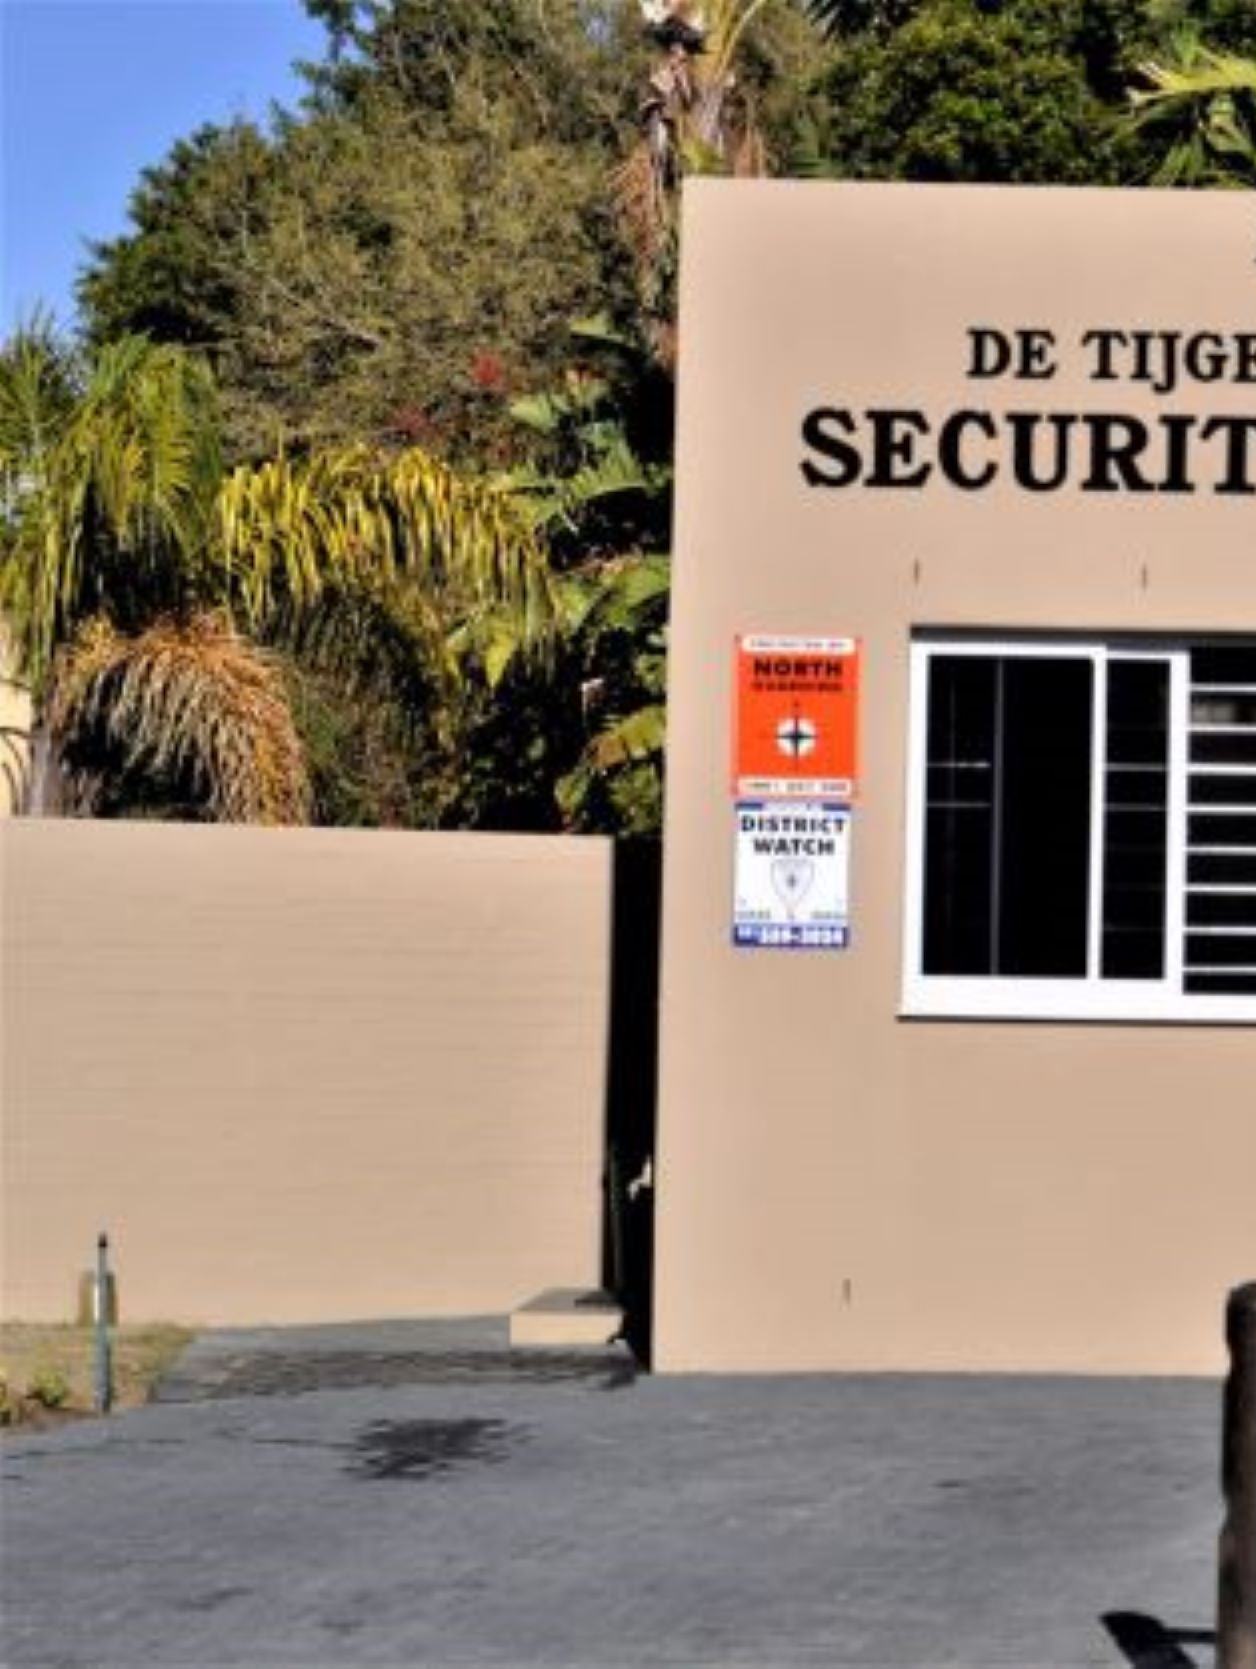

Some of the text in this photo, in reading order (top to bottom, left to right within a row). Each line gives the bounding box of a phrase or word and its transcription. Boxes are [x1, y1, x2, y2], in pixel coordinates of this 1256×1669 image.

[966, 328, 1058, 380] DE
[753, 658, 842, 678] NORTH
[741, 815, 845, 834] DISTRICT
[753, 837, 836, 857] WATCH
